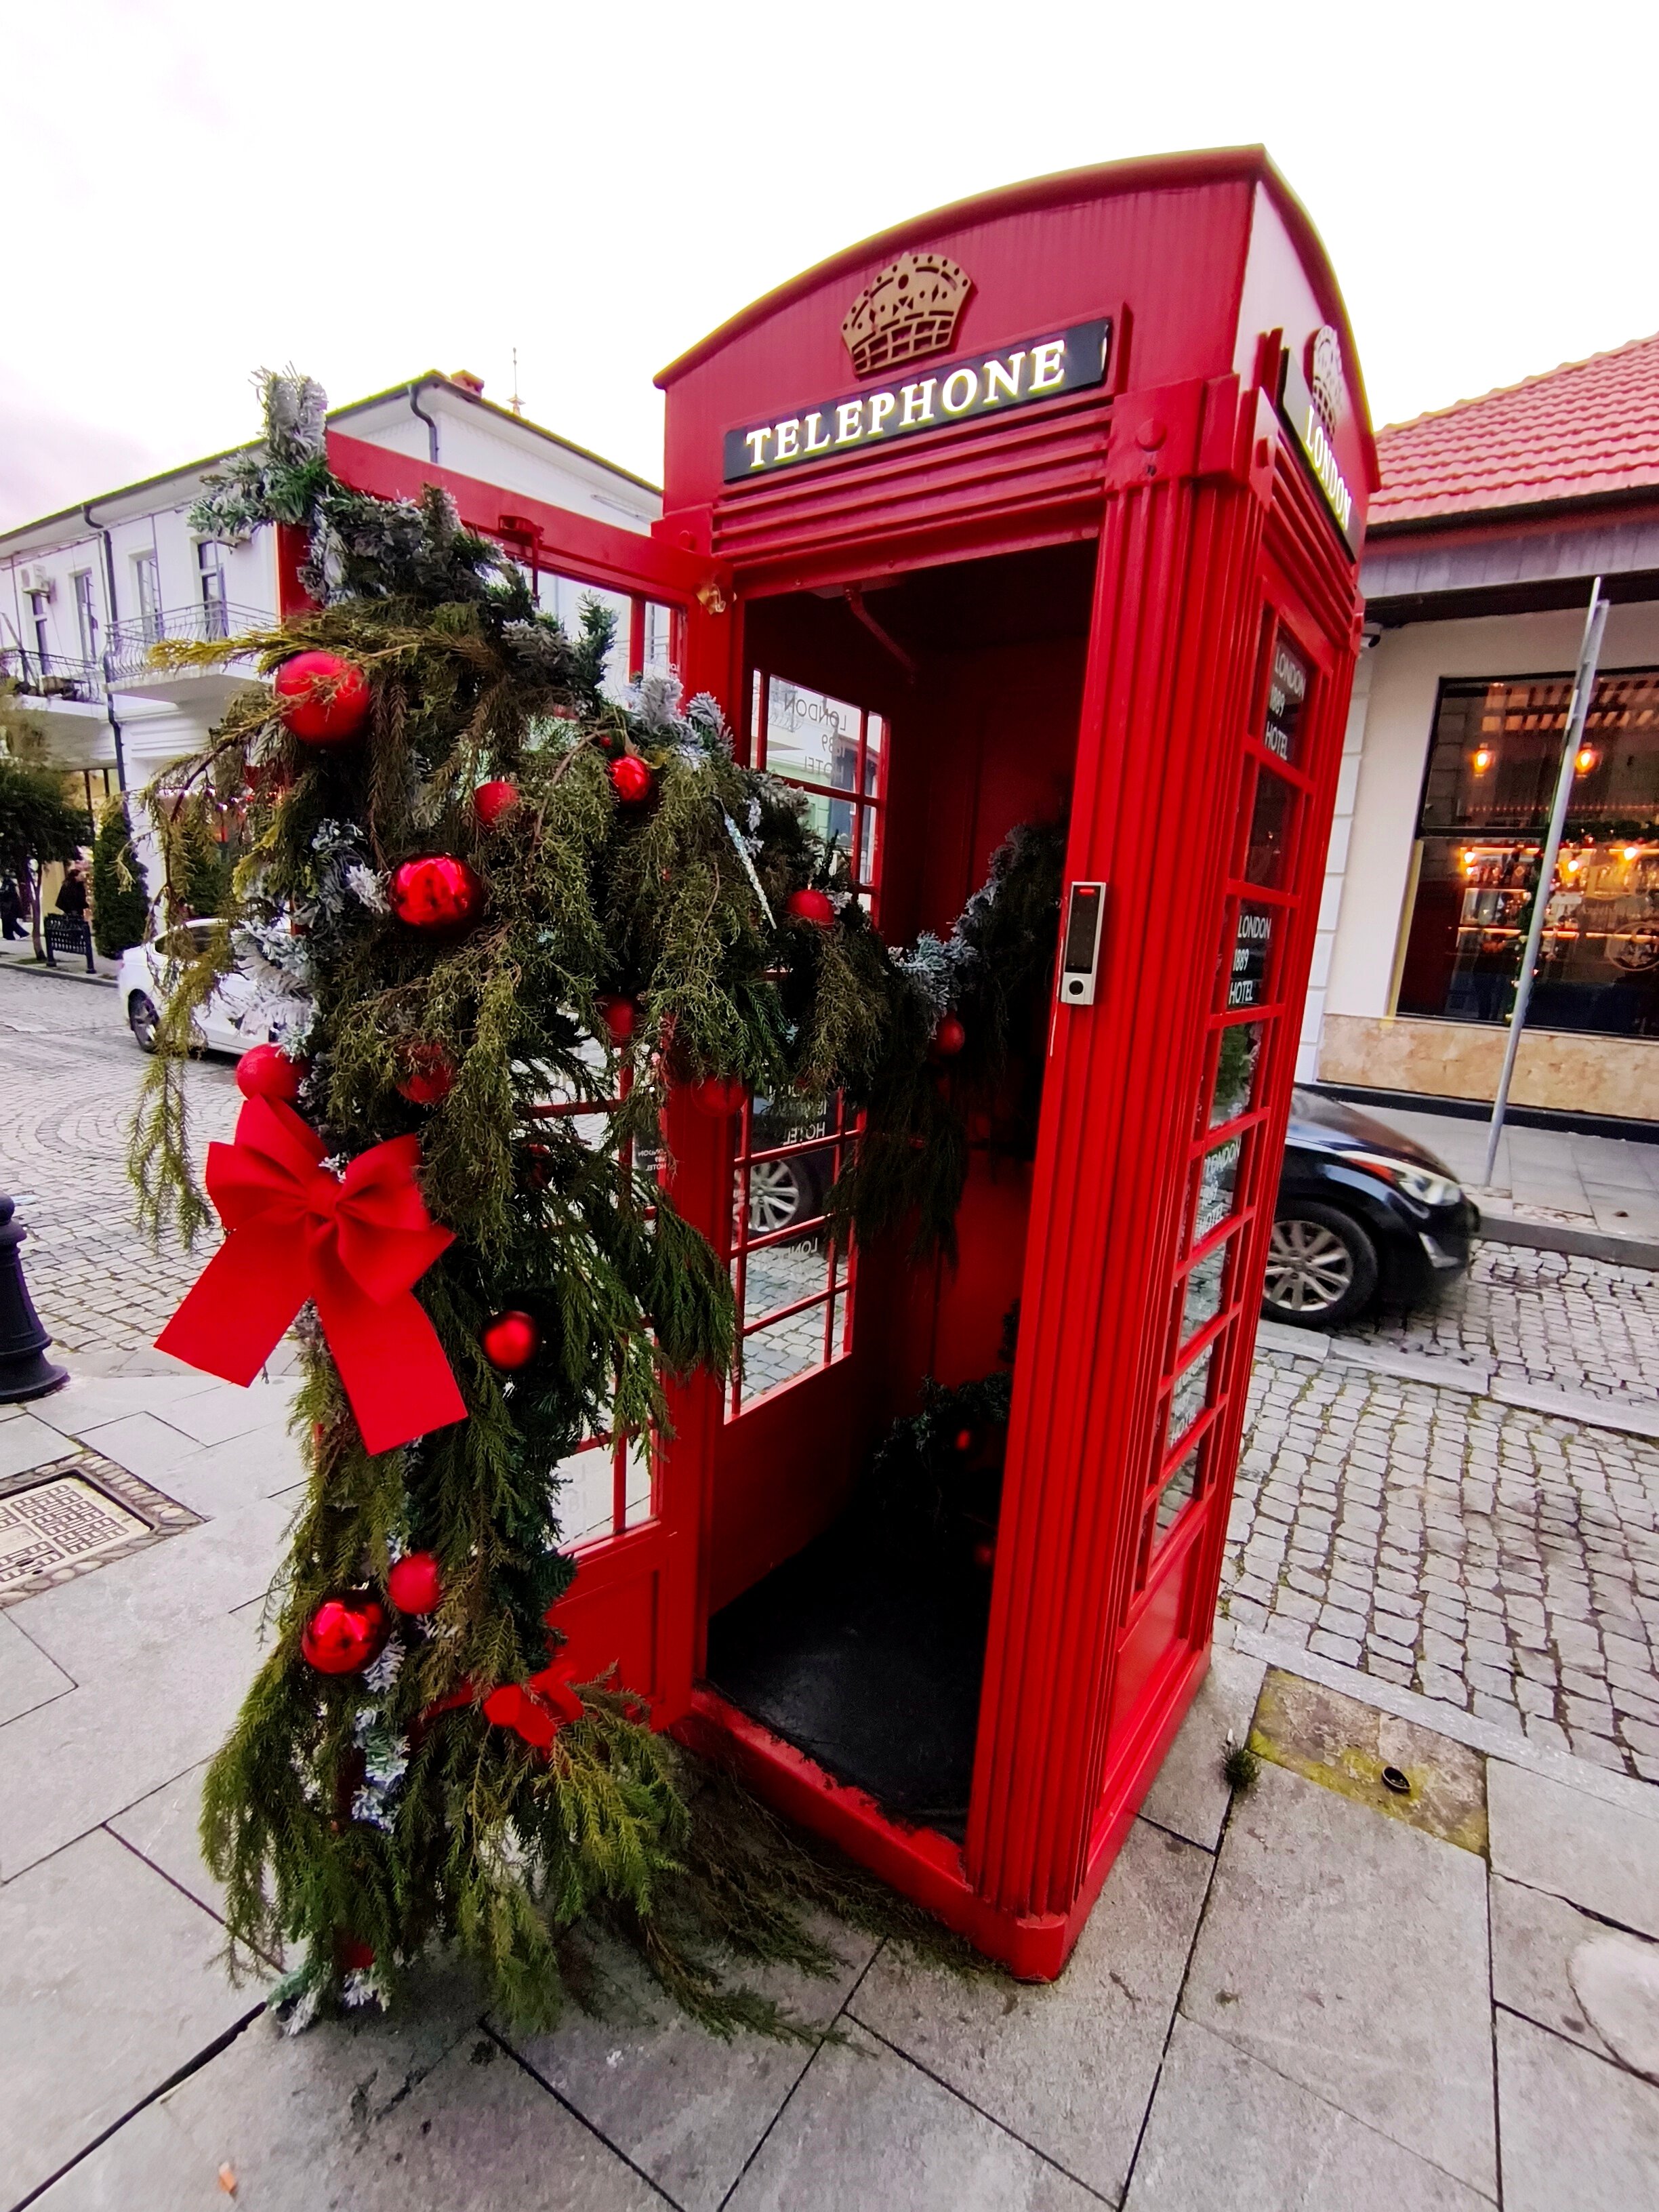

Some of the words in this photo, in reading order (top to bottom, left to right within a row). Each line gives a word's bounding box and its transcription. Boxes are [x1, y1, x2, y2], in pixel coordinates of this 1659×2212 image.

[745, 339, 1065, 468] TELEPHONE
[1305, 405, 1352, 531] LONDON
[1274, 645, 1307, 701] LONDON
[1265, 720, 1288, 760] HOTEL
[1237, 915, 1272, 939] LONDON
[1232, 948, 1250, 972] 1889
[1228, 981, 1253, 1005] HOTEL
